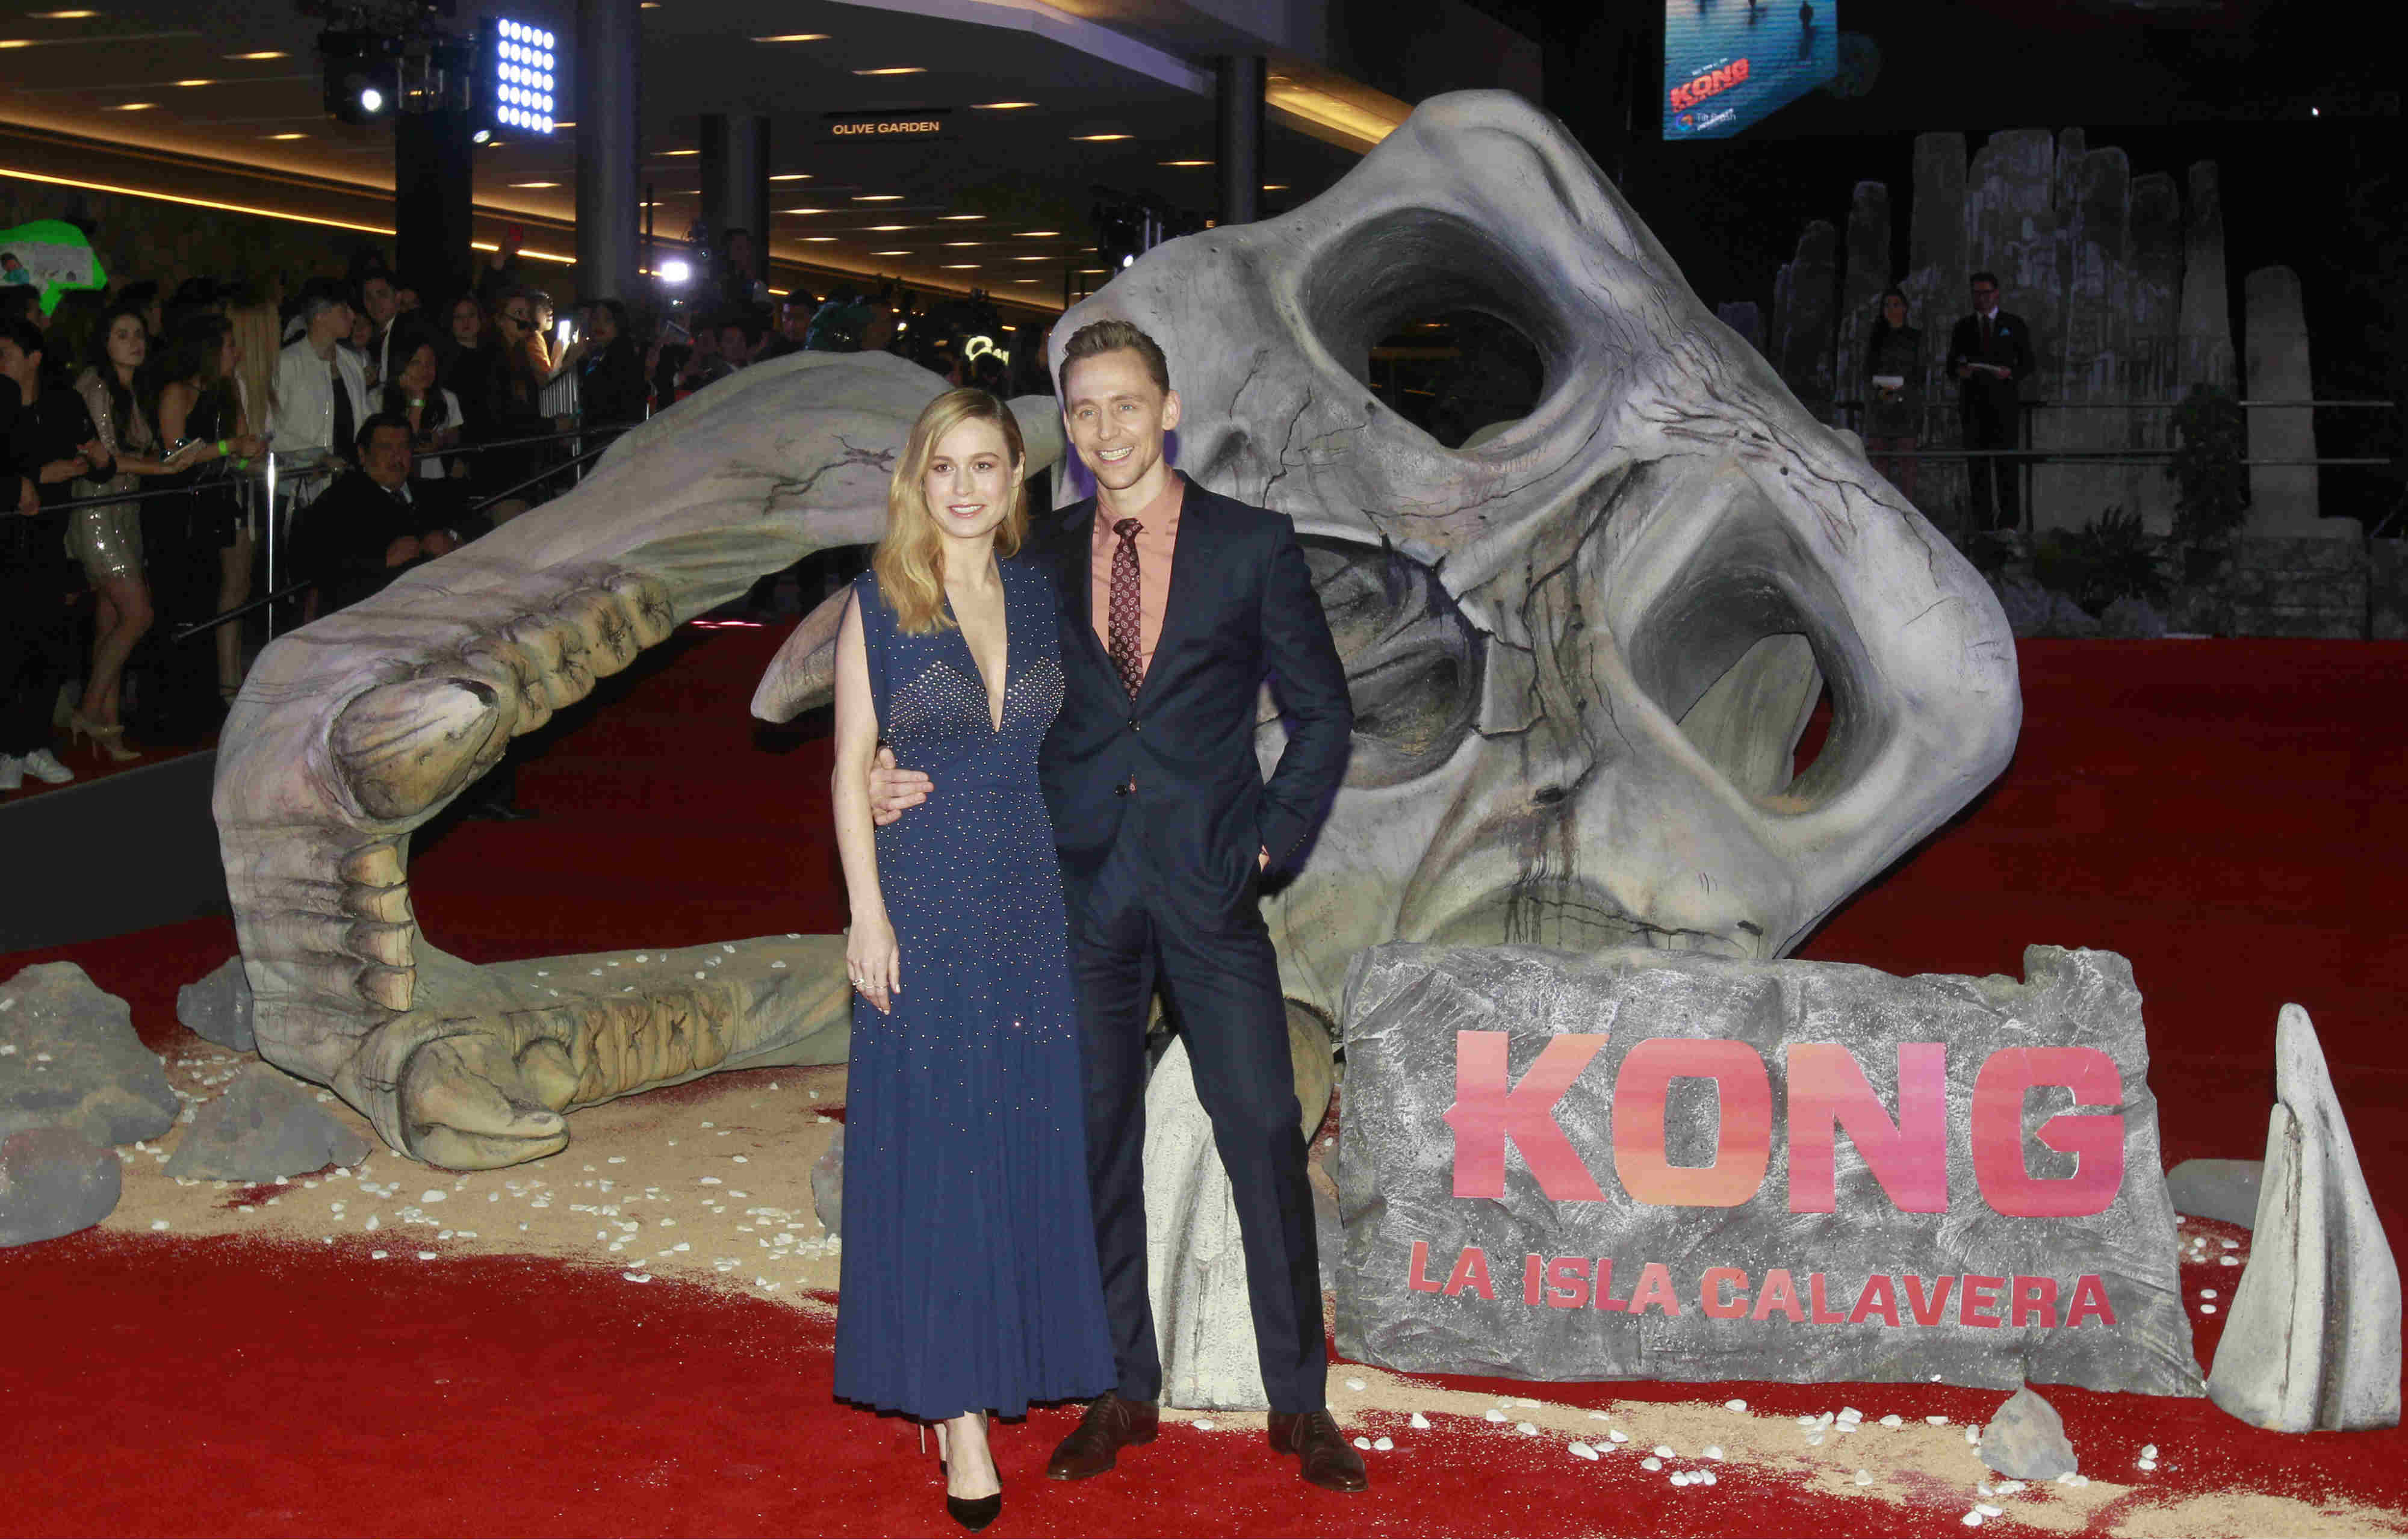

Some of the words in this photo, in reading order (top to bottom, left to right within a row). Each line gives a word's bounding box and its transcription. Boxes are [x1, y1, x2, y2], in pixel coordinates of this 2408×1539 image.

[1671, 58, 1749, 107] KONG
[833, 124, 875, 134] OLIVE
[878, 122, 940, 133] GARDEN
[1442, 1030, 2124, 1218] KONG
[1407, 1240, 1497, 1300] LA
[1522, 1253, 1681, 1316] ISLA
[1700, 1266, 2117, 1328] CALAVERA
